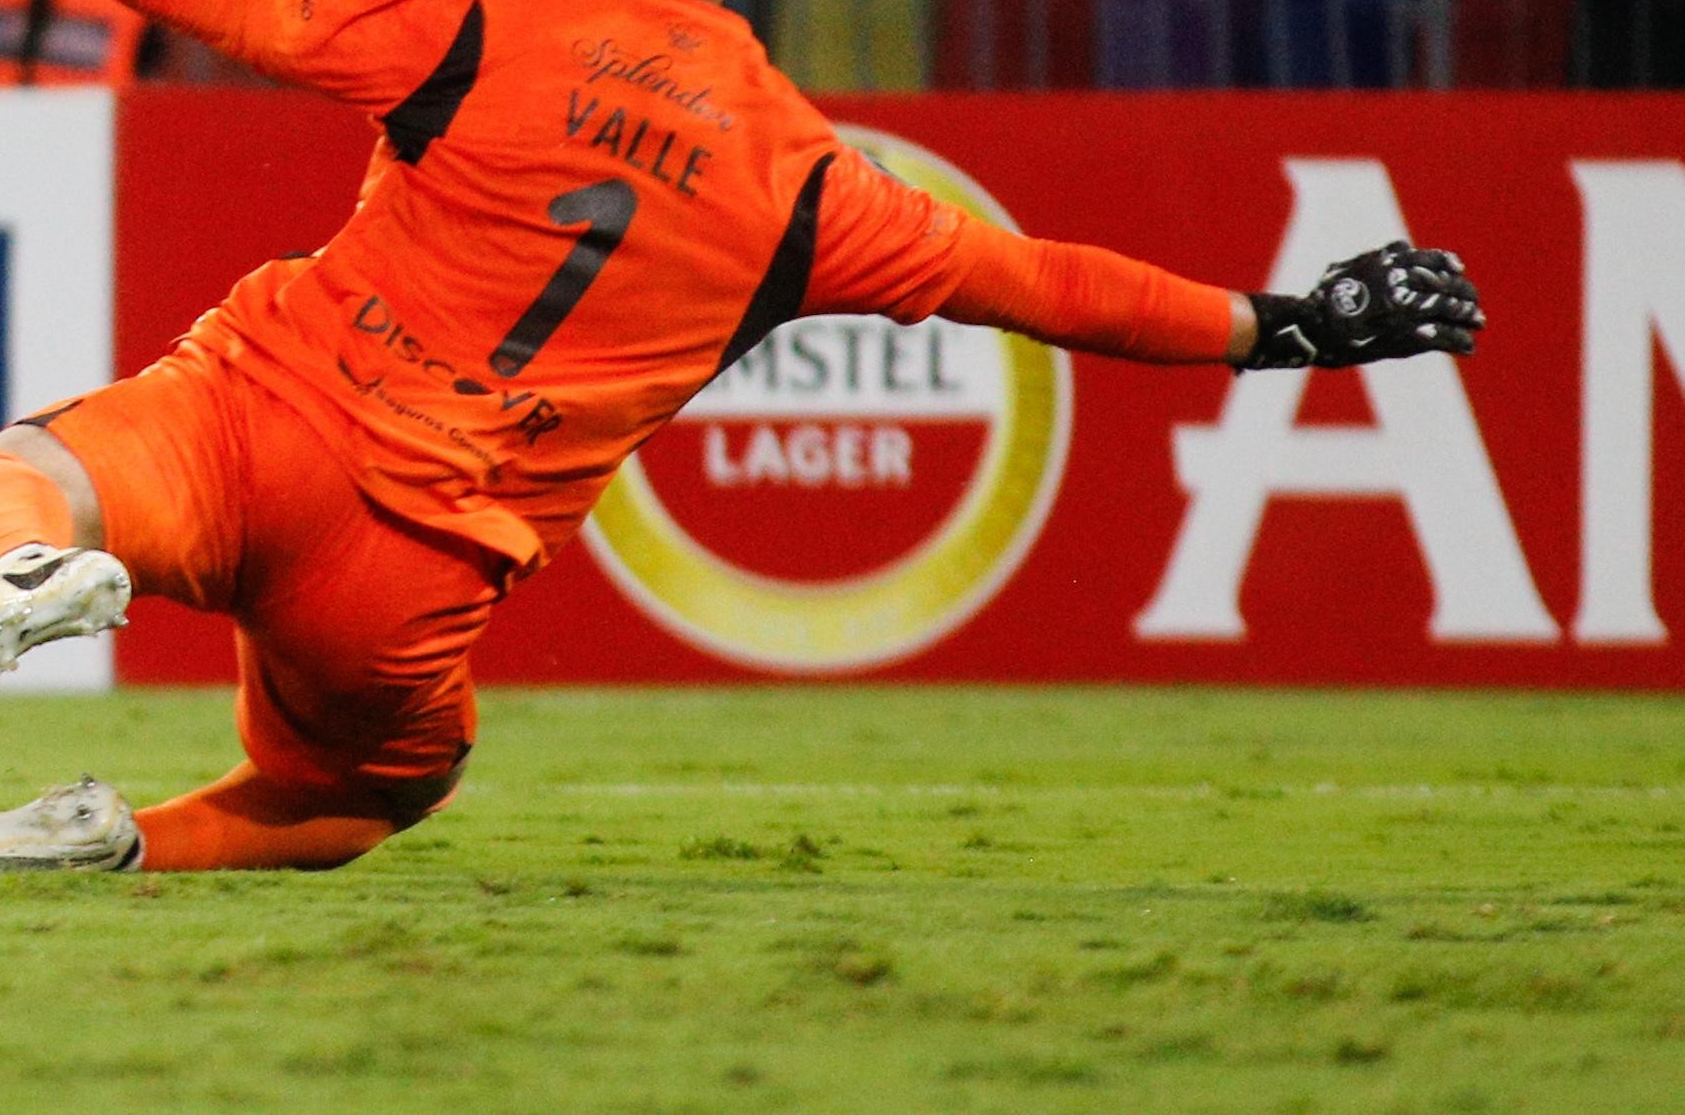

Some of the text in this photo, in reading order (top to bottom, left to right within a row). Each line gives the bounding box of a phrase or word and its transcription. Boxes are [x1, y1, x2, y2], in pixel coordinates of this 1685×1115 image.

[567, 87, 713, 197] VALLE
[488, 177, 639, 378] 1
[711, 319, 967, 393] MSTEL
[703, 423, 913, 489] LAGER
